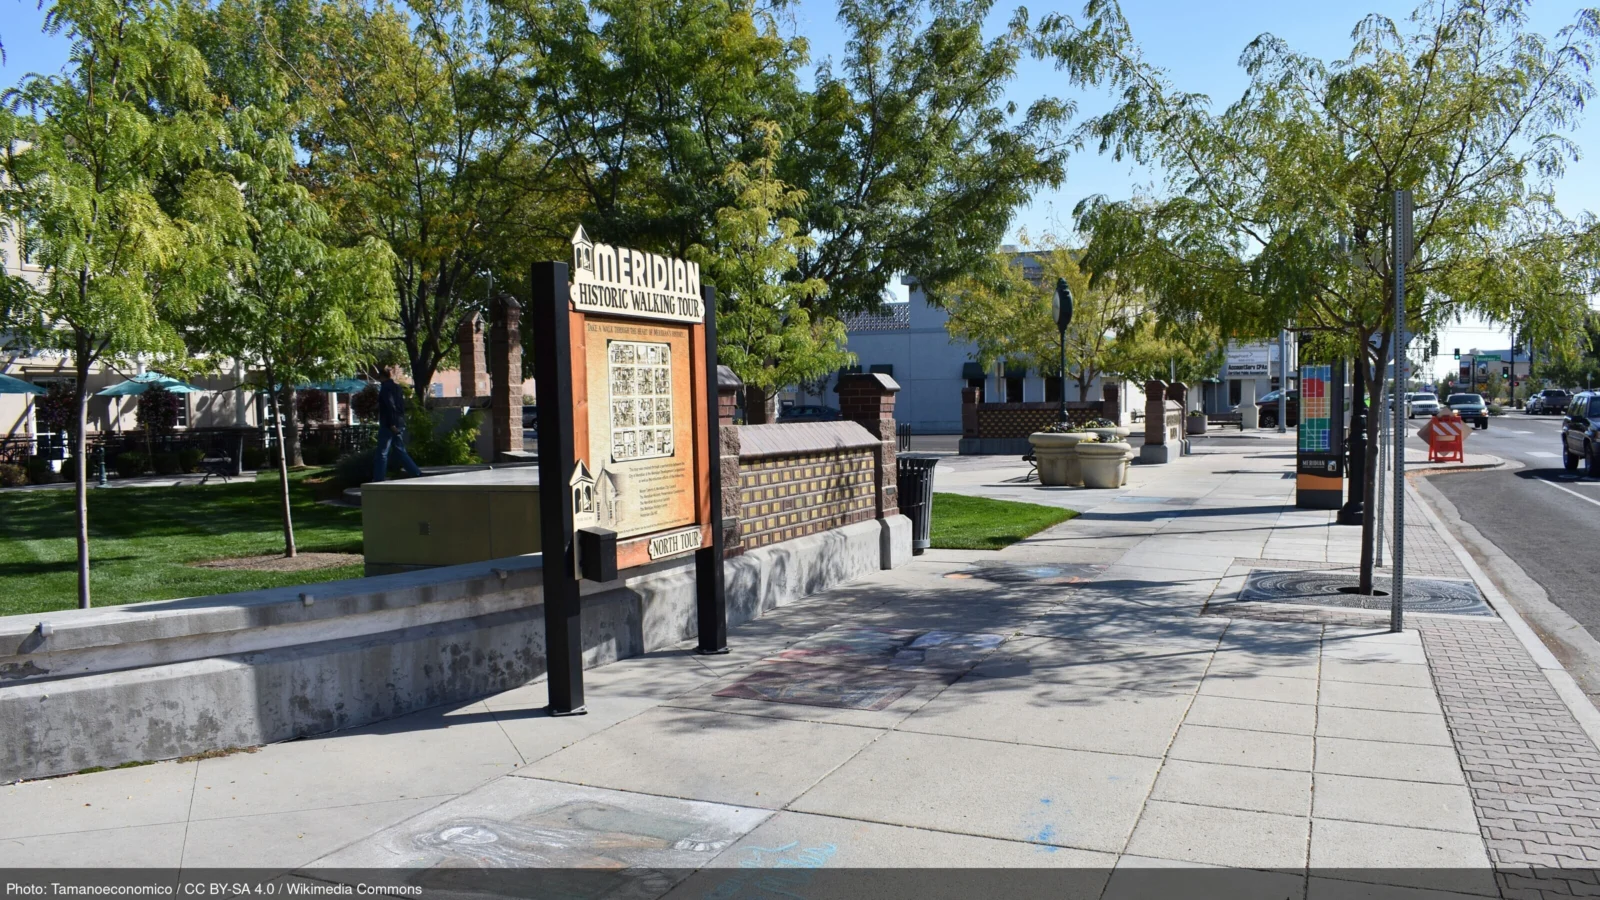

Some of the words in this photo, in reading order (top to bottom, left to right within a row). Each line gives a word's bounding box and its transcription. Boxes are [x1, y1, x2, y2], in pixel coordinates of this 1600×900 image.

[593, 242, 699, 295] MERIDIAN
[579, 282, 629, 308] HISTORIC
[630, 289, 676, 315] WALKING
[677, 297, 700, 318] TOUR
[652, 536, 678, 557] NORTH
[681, 531, 699, 548] TOUR
